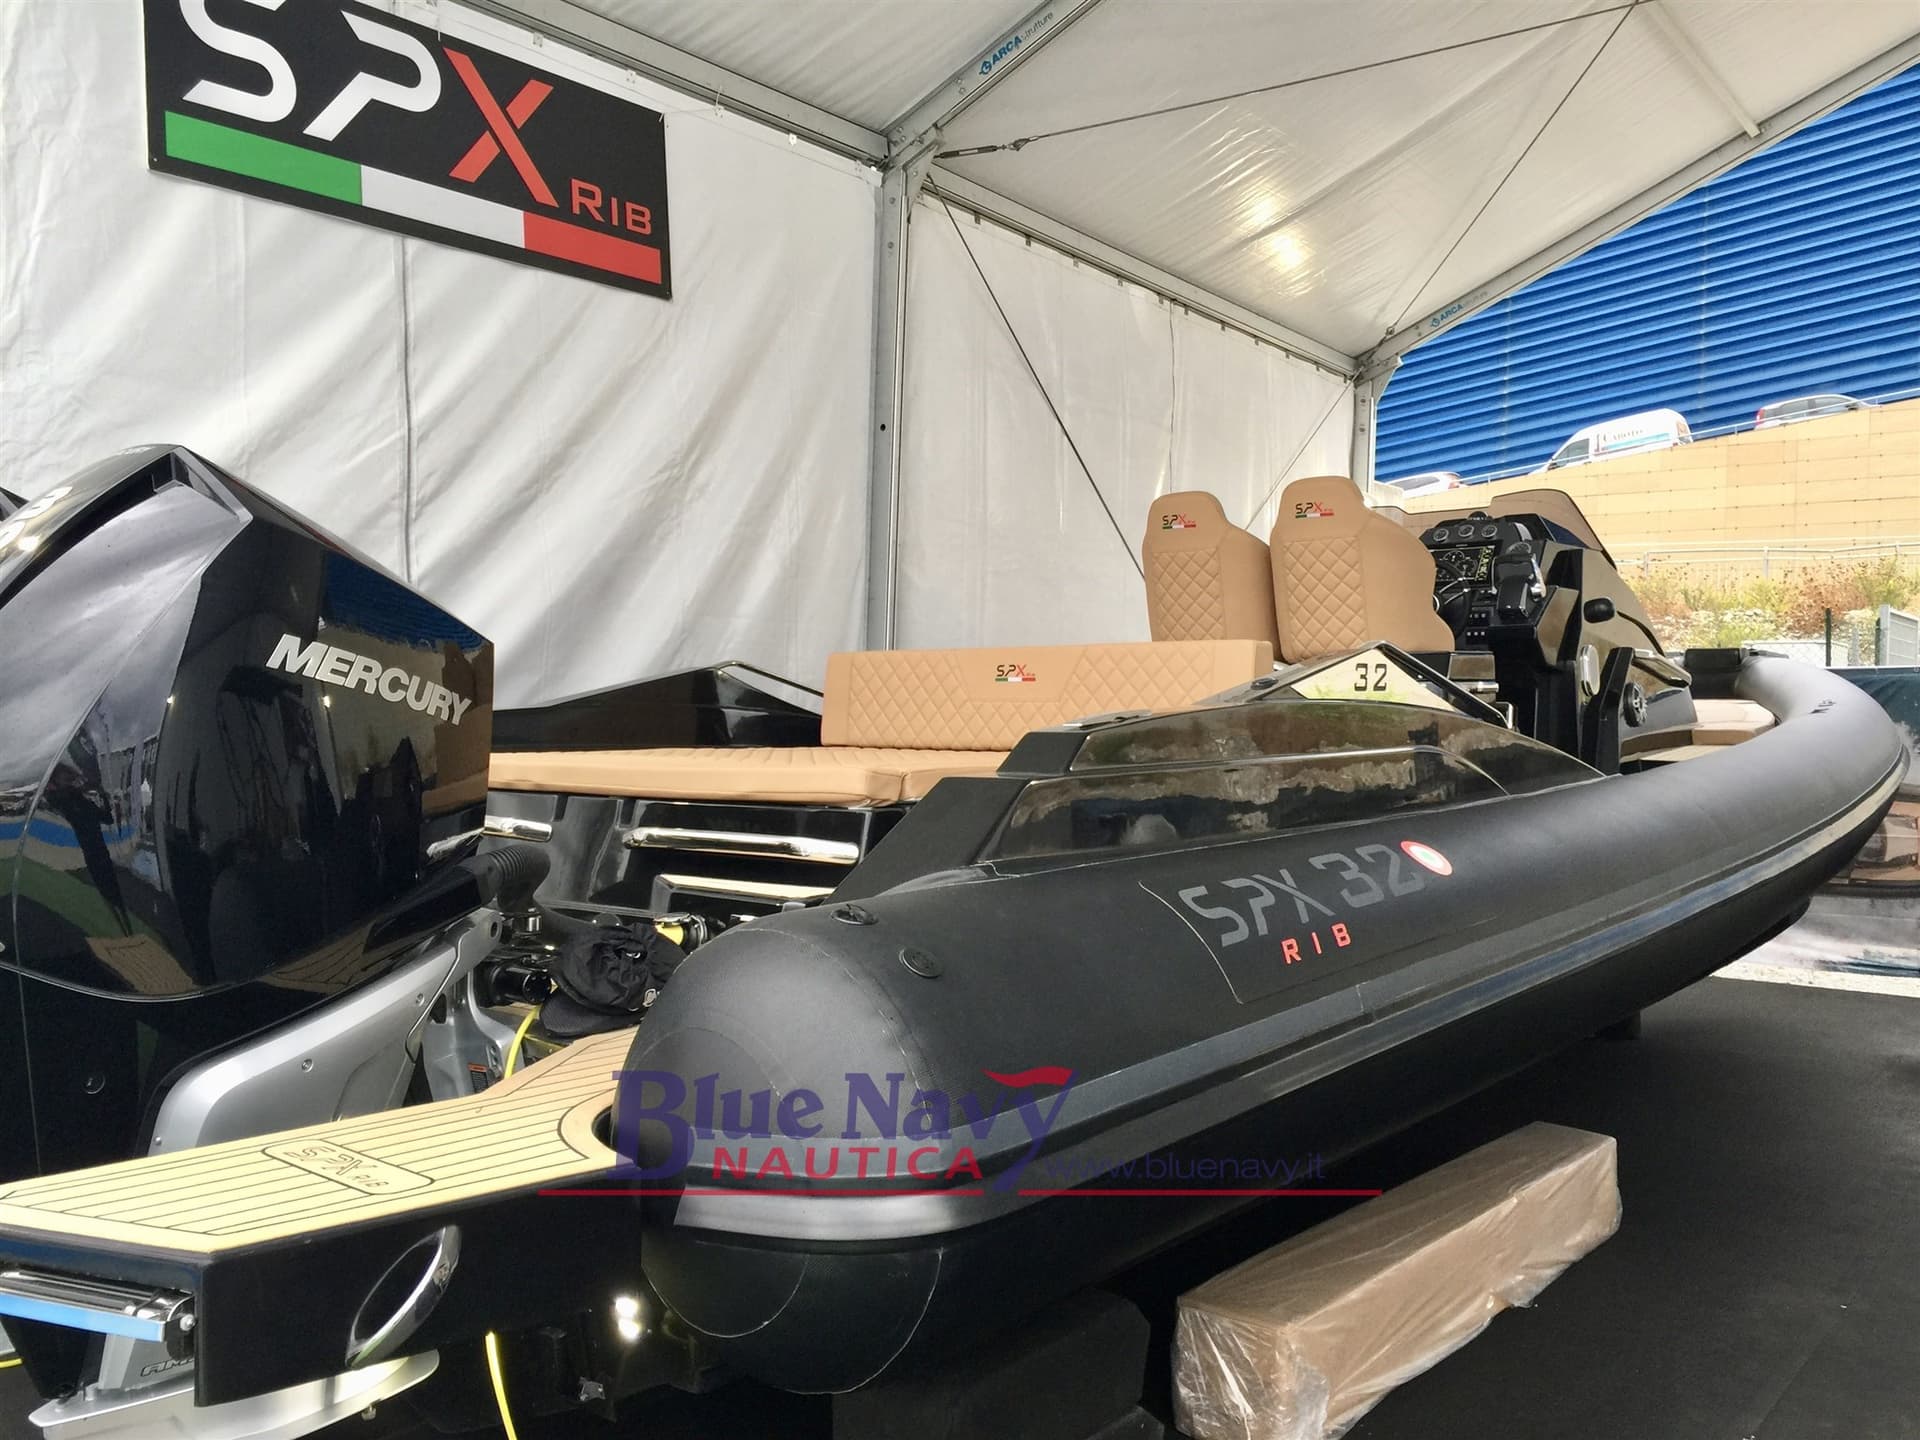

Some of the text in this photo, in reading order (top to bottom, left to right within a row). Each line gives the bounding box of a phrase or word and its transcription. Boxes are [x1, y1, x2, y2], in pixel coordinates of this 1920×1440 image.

[991, 35, 1023, 66] ARCA
[181, 0, 653, 236] SPX RIB
[1440, 303, 1464, 321] ARCA
[1162, 513, 1186, 526] SPX
[1295, 501, 1323, 514] SPX
[265, 633, 472, 726] MERCURY
[996, 664, 1027, 677] SPX
[1354, 663, 1387, 691] 32
[1178, 844, 1425, 948] SPX 32
